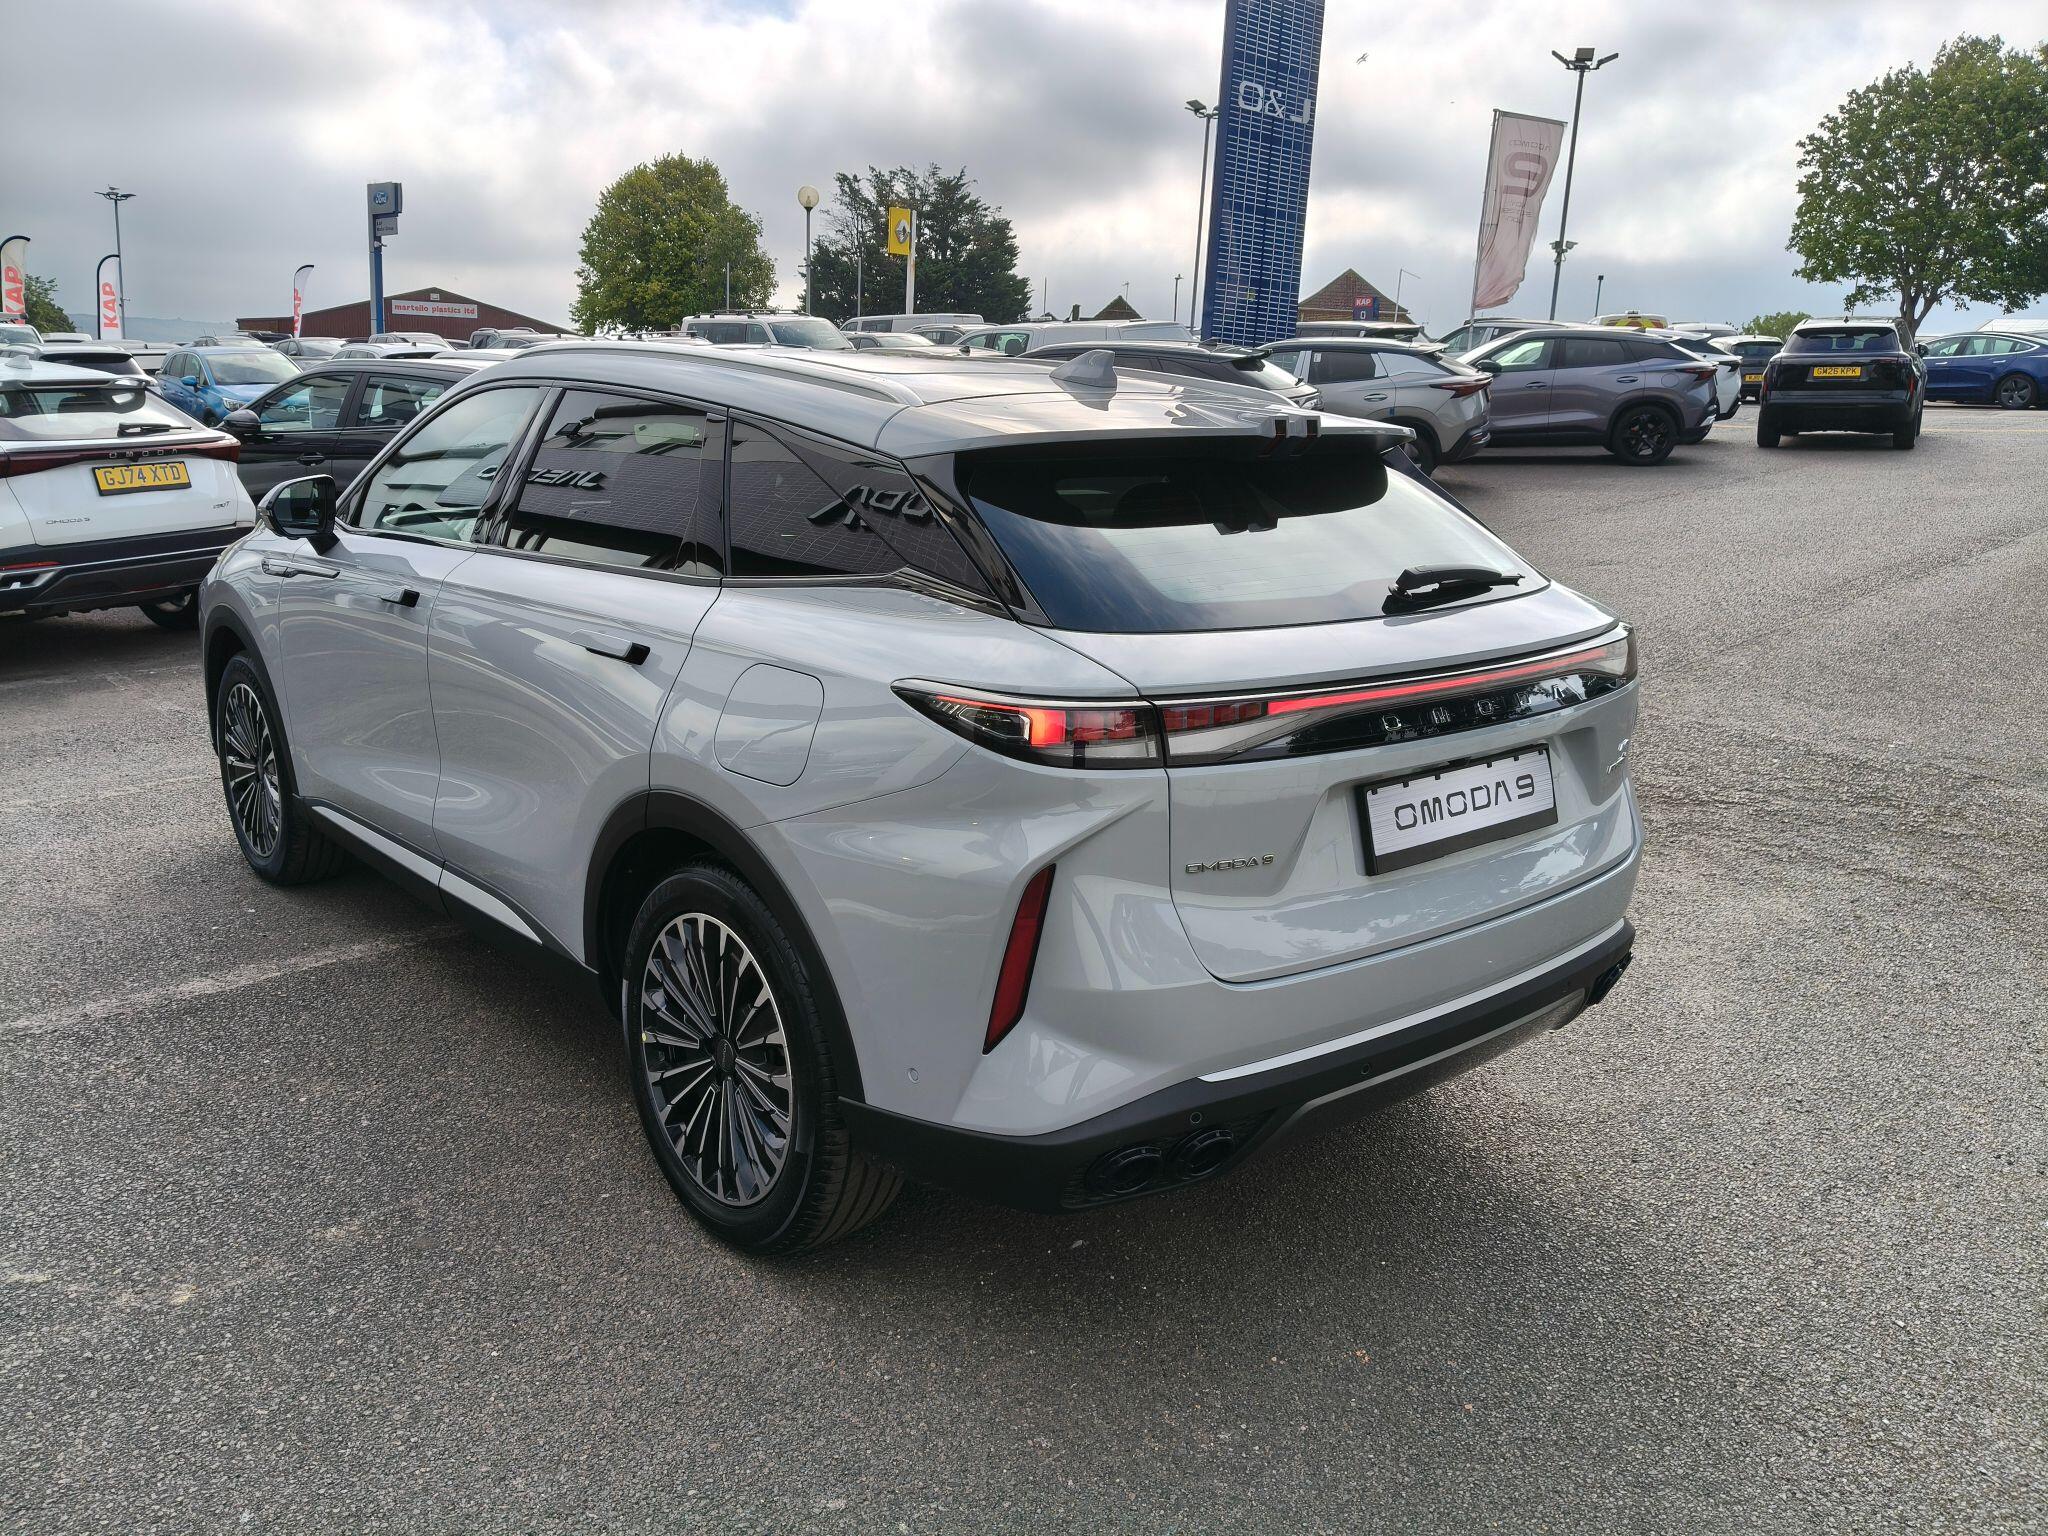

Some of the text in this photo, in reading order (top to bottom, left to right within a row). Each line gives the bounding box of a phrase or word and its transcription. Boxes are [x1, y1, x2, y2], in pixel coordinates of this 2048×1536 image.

[1238, 80, 1312, 125] O&J
[102, 281, 119, 329] KAP
[394, 304, 475, 315] martello plastics ltd
[1356, 298, 1371, 306] KAP
[103, 464, 182, 487] GJ74 XTD
[1394, 773, 1535, 831] OMODA 9
[1184, 853, 1275, 874] OMODA 9
